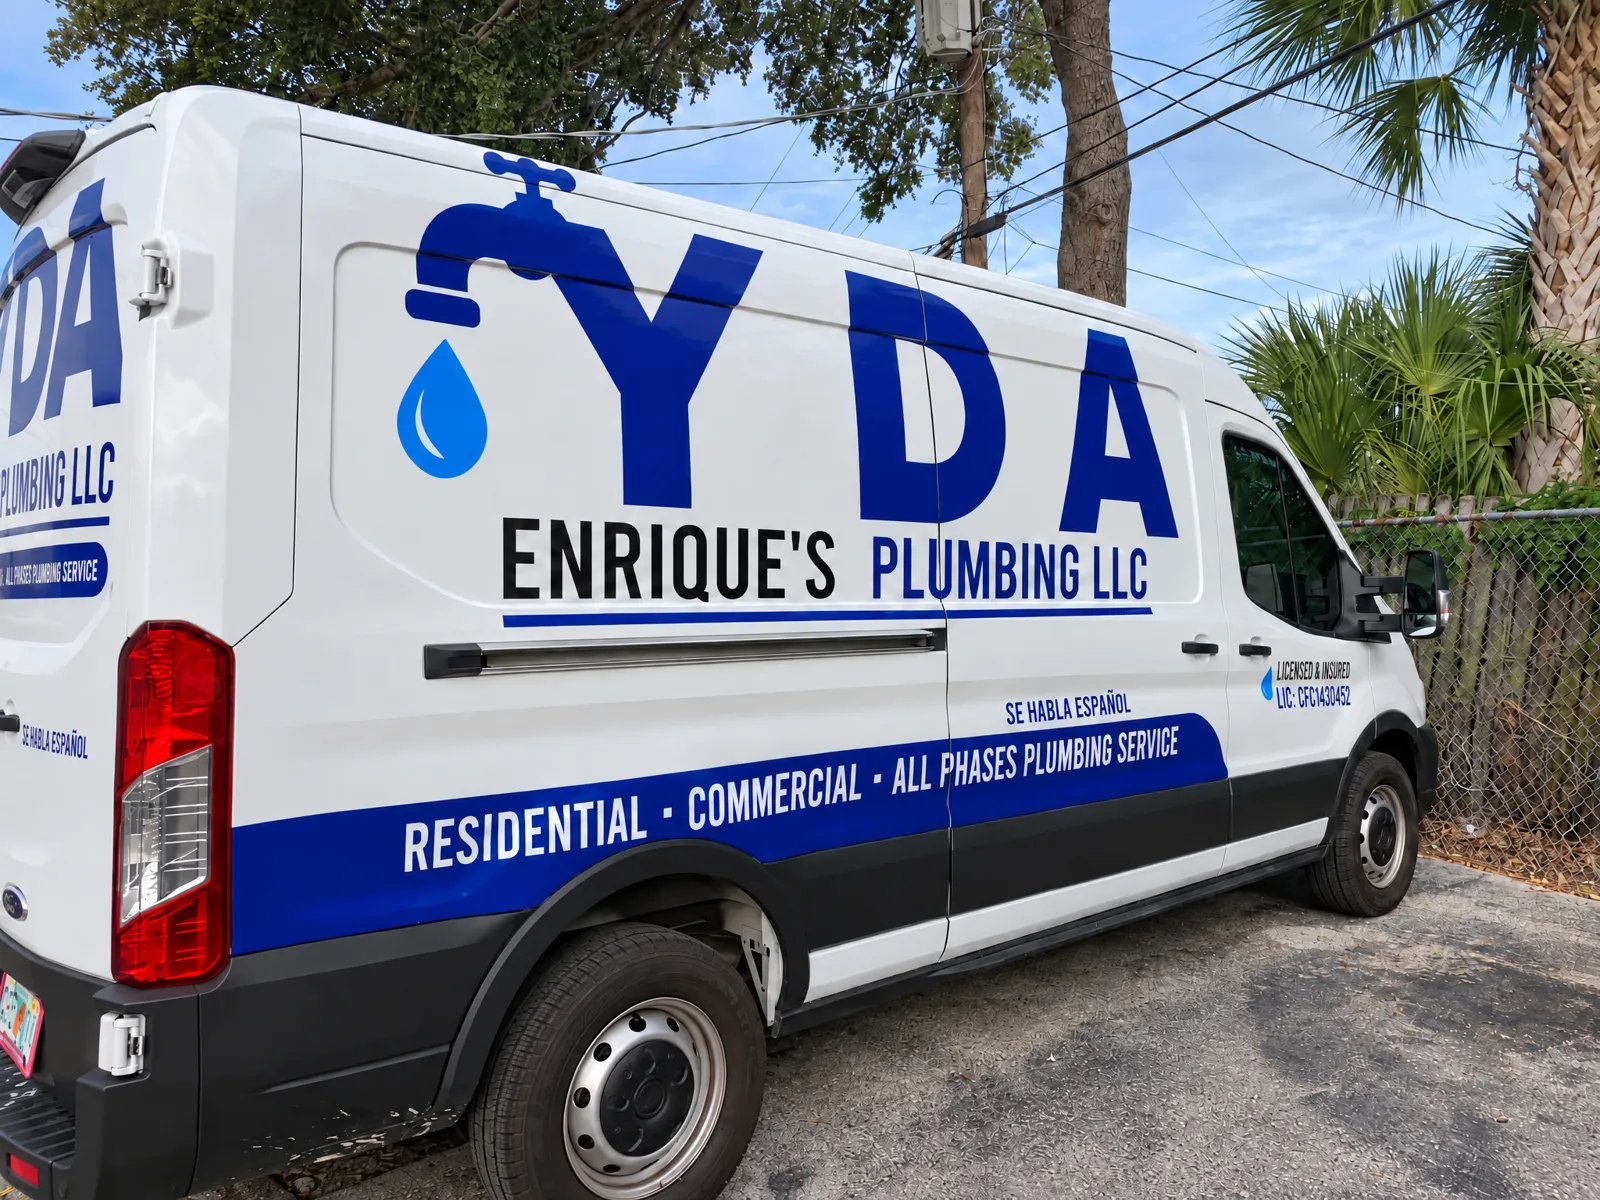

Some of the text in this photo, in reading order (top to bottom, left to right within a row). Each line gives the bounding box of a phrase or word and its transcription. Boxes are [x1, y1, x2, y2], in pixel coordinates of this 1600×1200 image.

[550, 229, 1179, 539] YDA
[71, 441, 115, 503] LLC
[62, 559, 98, 583] SERVICE
[503, 517, 1147, 602] ENRIQUE'S PLUMBING LLC
[1277, 661, 1351, 681] LICENSED & INSURED
[1005, 689, 1132, 725] SE HABLA ESPAÑOL
[1276, 685, 1351, 710] LIC: CFC1430452
[22, 723, 89, 760] SE HABLA ESPAÑOL
[403, 725, 1180, 873] RESIDENTIAL COMMERCIAL ALL PHASES PLUMBING SERVICE
